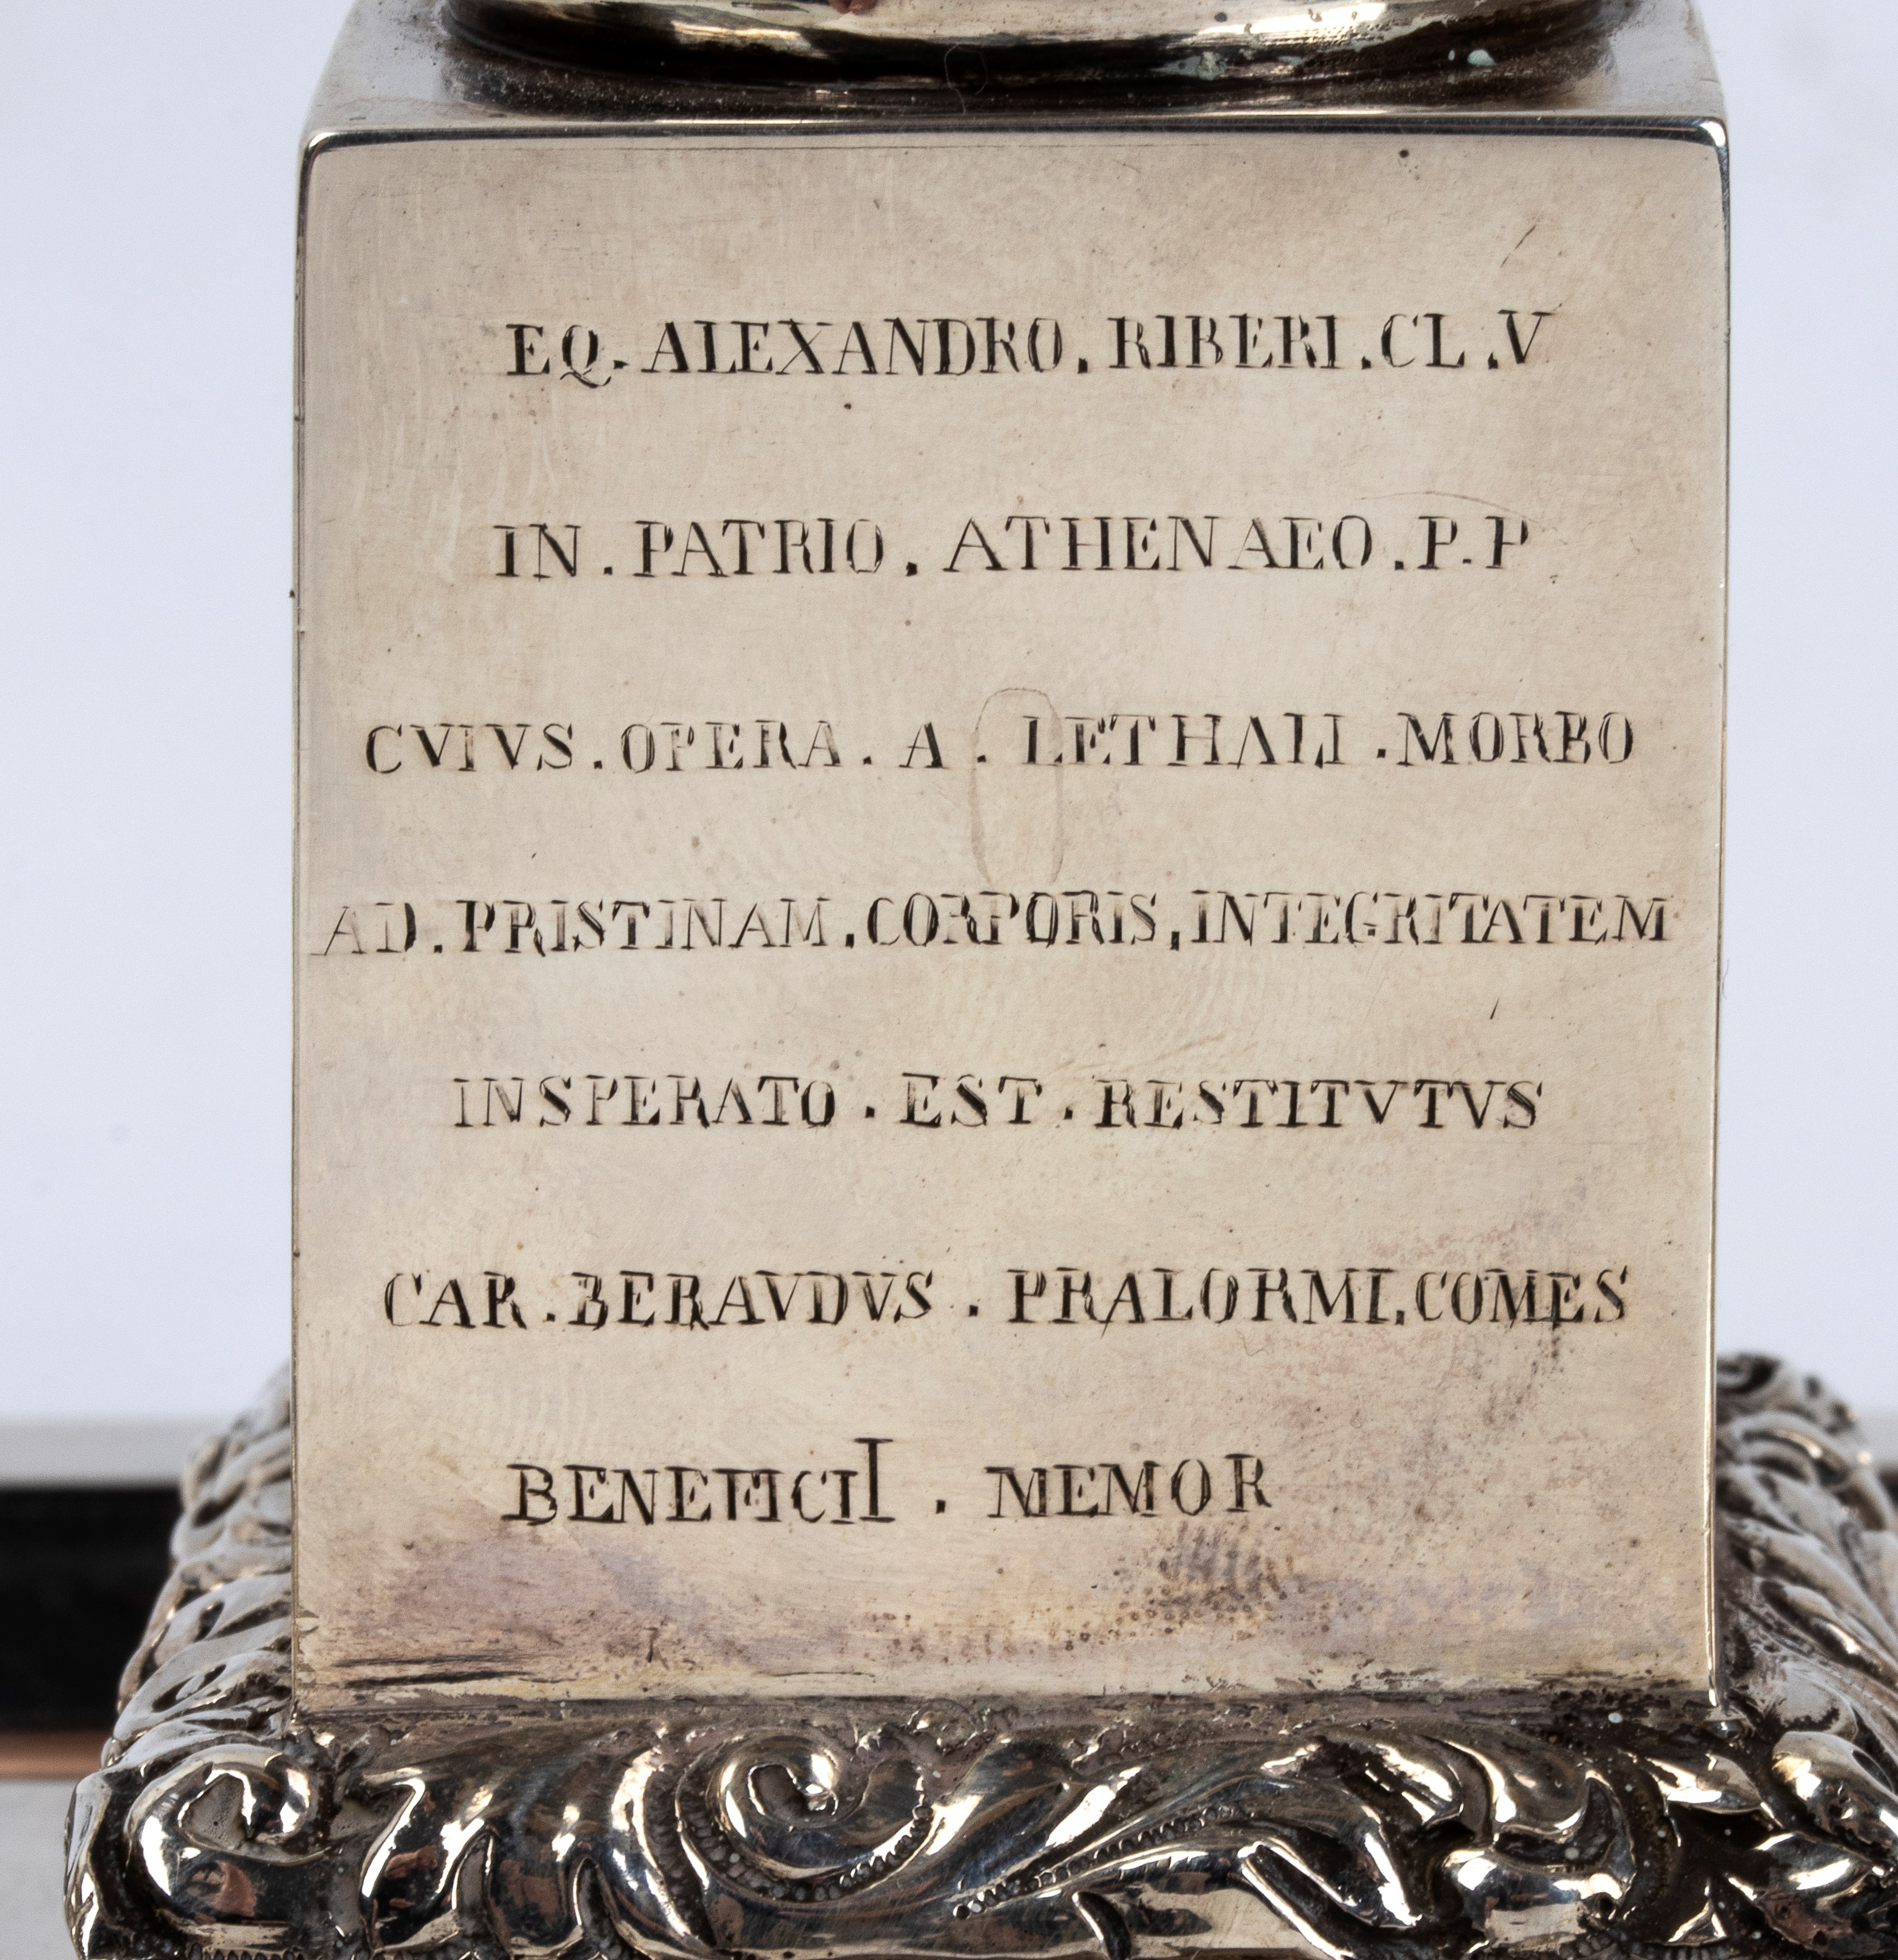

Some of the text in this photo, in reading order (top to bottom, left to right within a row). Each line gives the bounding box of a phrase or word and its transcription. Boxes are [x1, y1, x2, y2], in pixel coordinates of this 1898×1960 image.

[1498, 309, 1553, 366] V
[1396, 711, 1633, 767] MORBO
[1191, 889, 1670, 946] INTEGRITATEM
[1093, 1079, 1542, 1130] RESTITVTVS
[1415, 1266, 1628, 1329] COMES
[984, 1453, 1272, 1518] MEMOR
